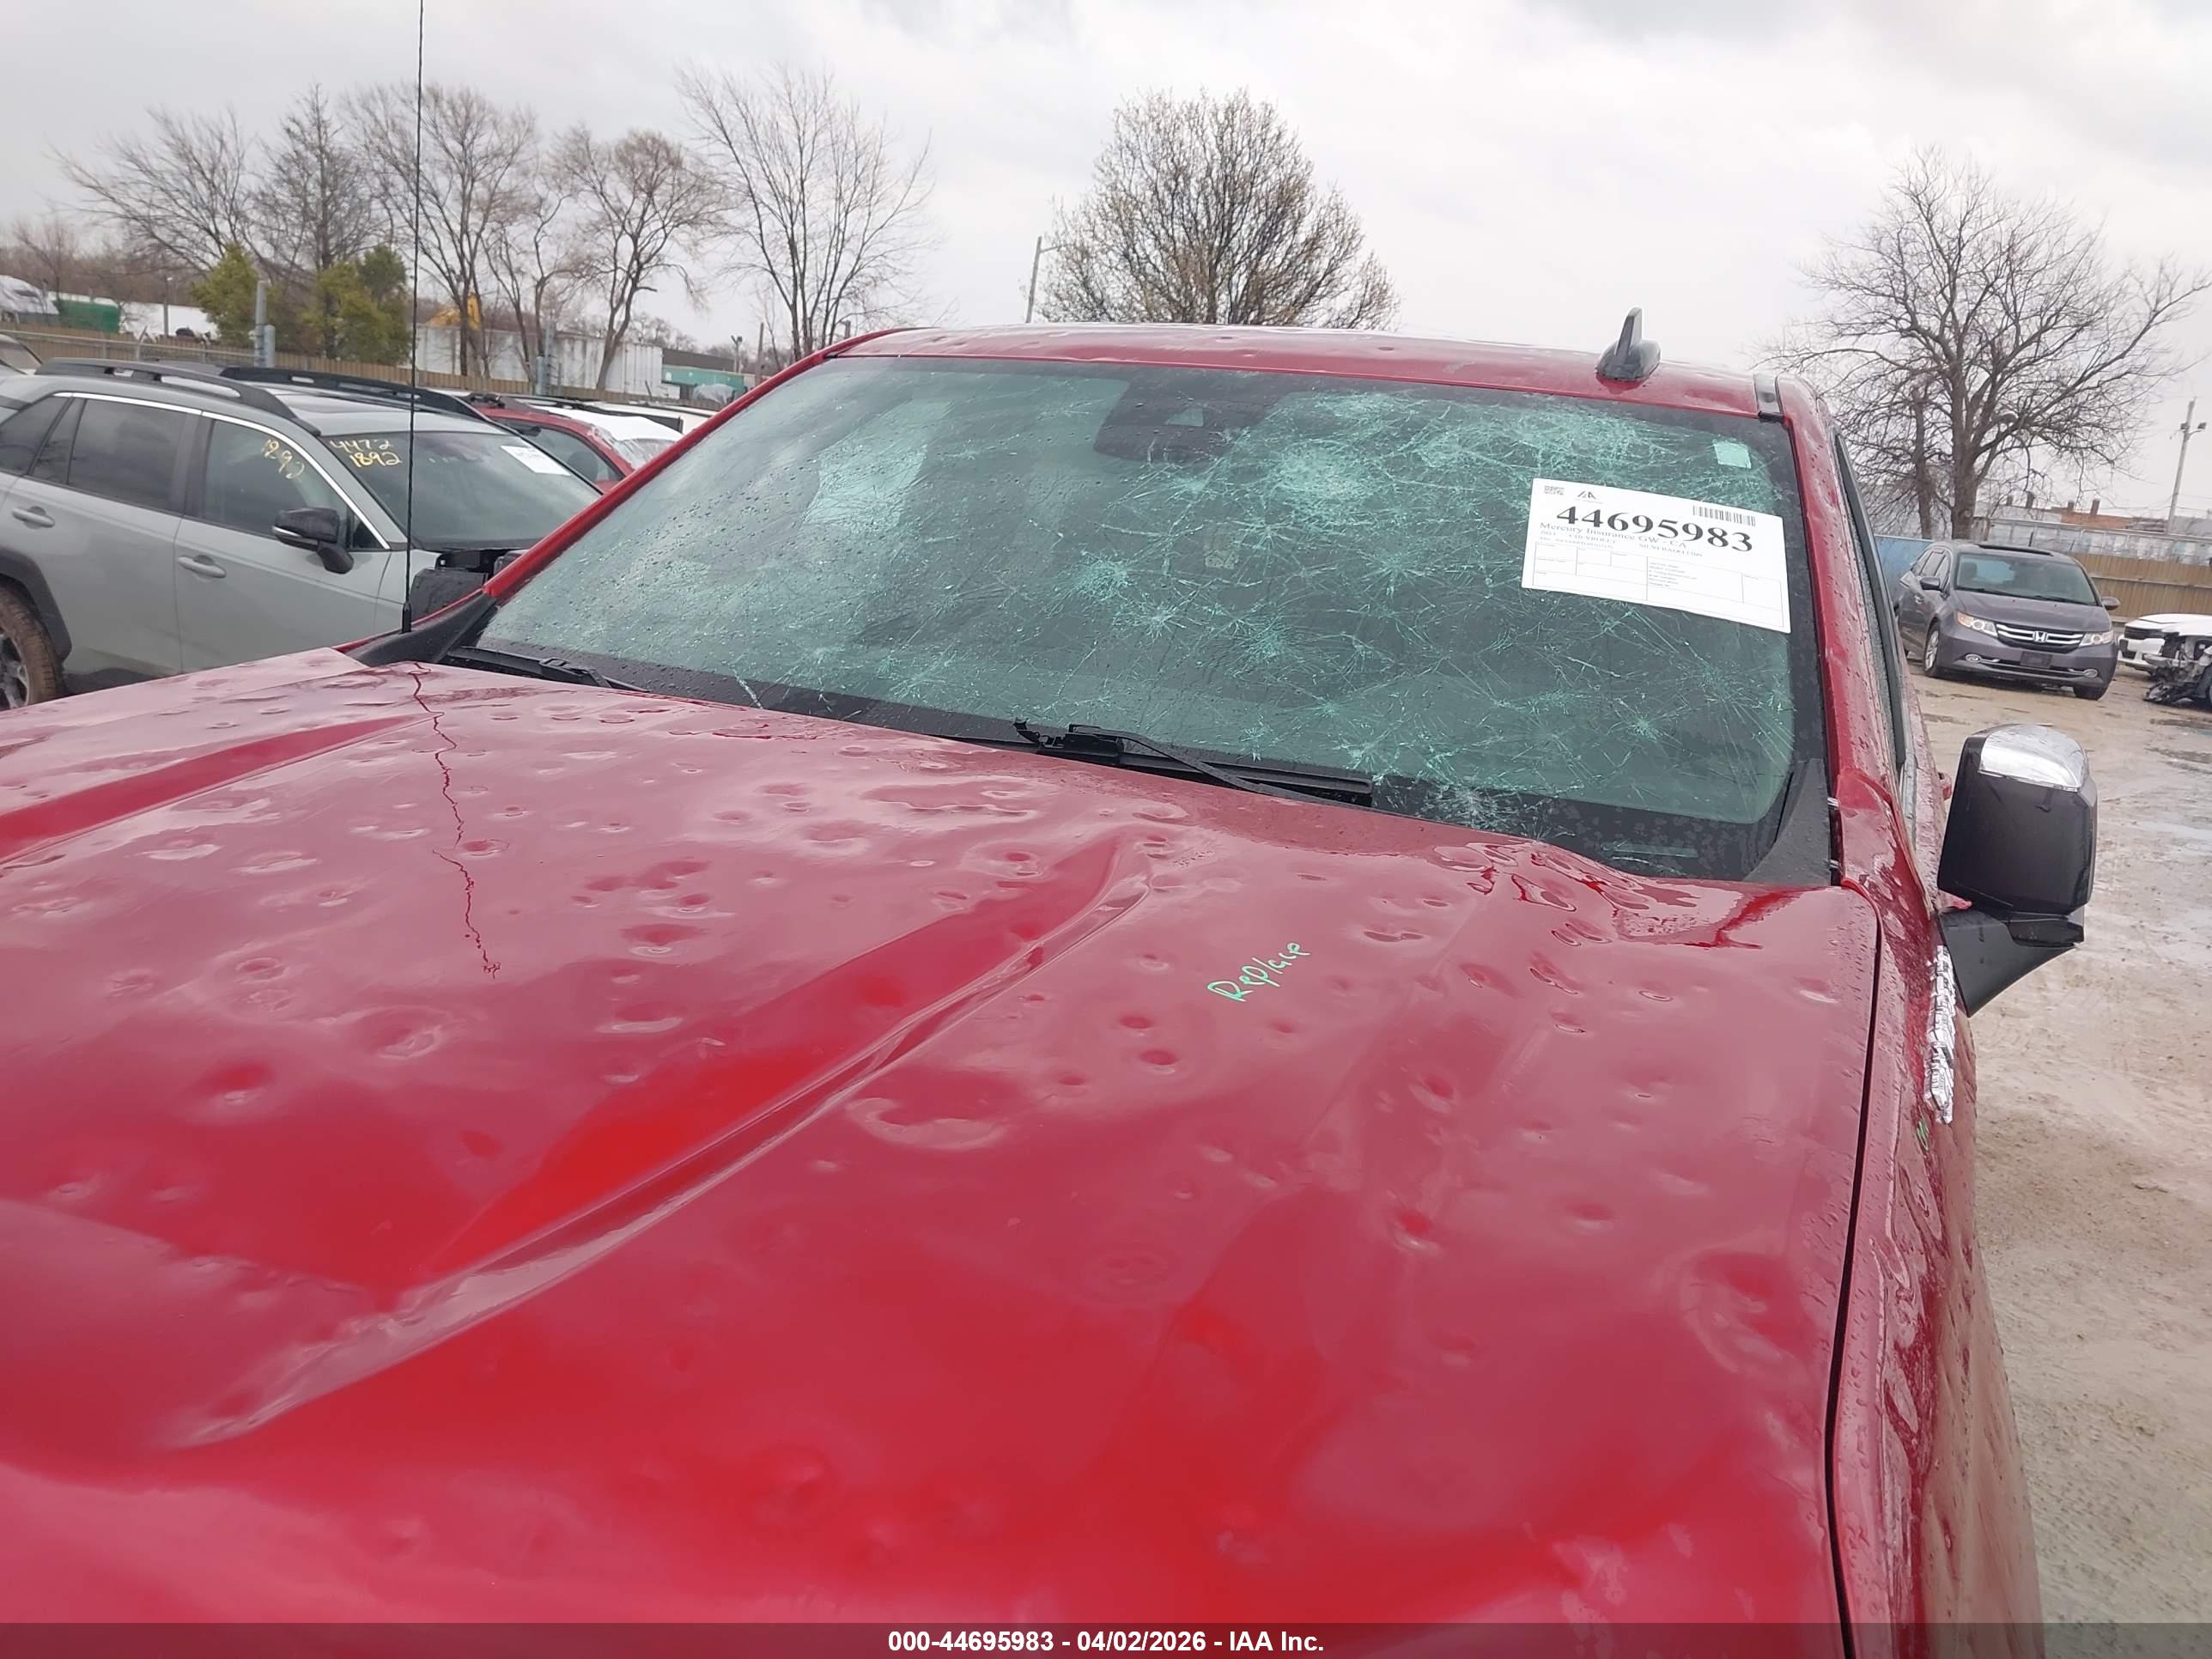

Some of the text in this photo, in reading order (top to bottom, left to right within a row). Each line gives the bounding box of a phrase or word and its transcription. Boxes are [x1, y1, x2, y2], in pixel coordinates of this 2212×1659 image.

[330, 439, 392, 453] 4472
[349, 451, 402, 468] 1892
[1540, 522, 1583, 534] Mercury
[1587, 528, 1635, 540] Insurance
[1638, 534, 1660, 544] GW
[1669, 540, 1686, 549] CA
[1556, 505, 1753, 552] 44695983
[1207, 942, 1311, 1002] Replace
